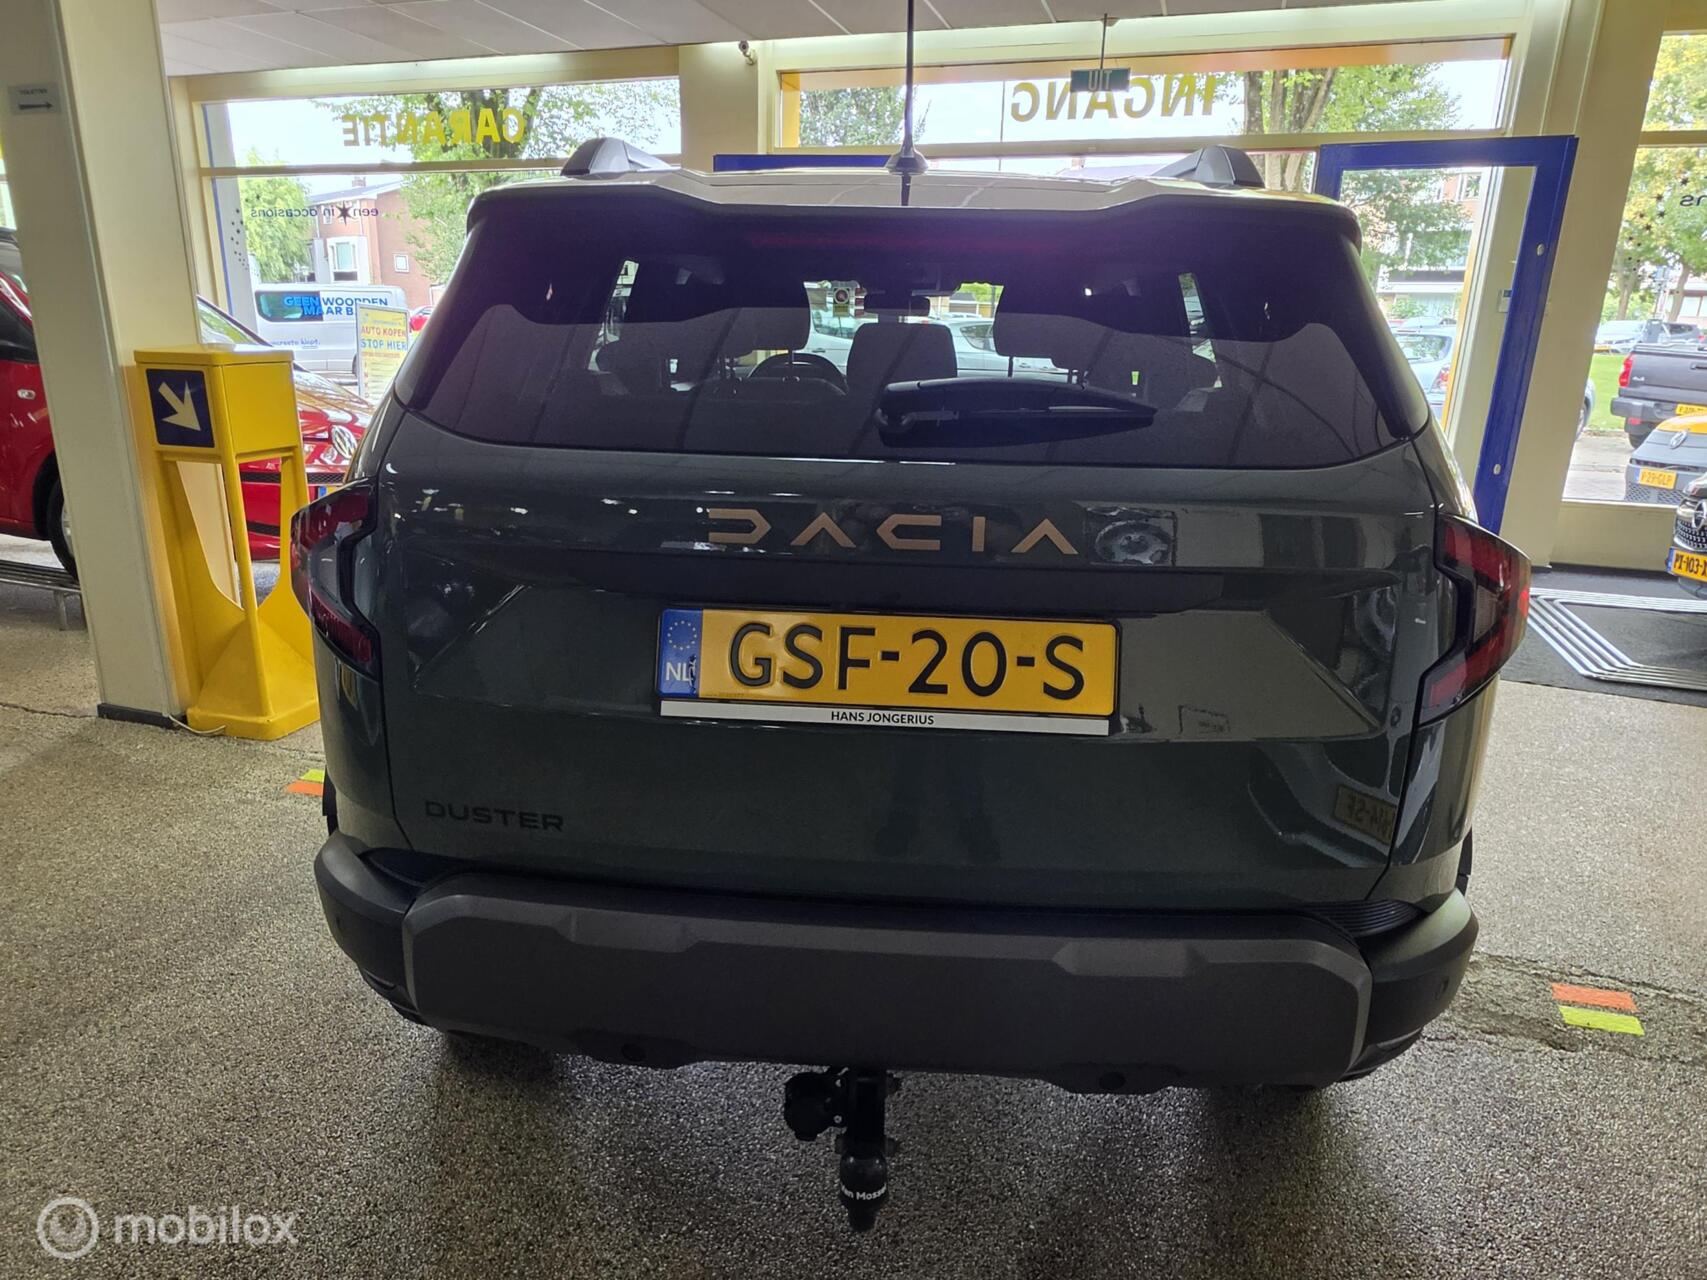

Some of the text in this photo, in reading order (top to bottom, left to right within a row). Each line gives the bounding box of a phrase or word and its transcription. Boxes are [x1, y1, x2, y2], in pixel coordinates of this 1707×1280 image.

[1087, 69, 1113, 91] UIT
[284, 296, 321, 307] GEEN
[303, 305, 342, 316] MAAR
[360, 338, 385, 349] STOP
[708, 507, 1079, 555] DACIA
[729, 621, 1085, 701] GSF-20-S
[831, 710, 934, 726] HANS JONGERIUS
[424, 800, 565, 832] DUSTER
